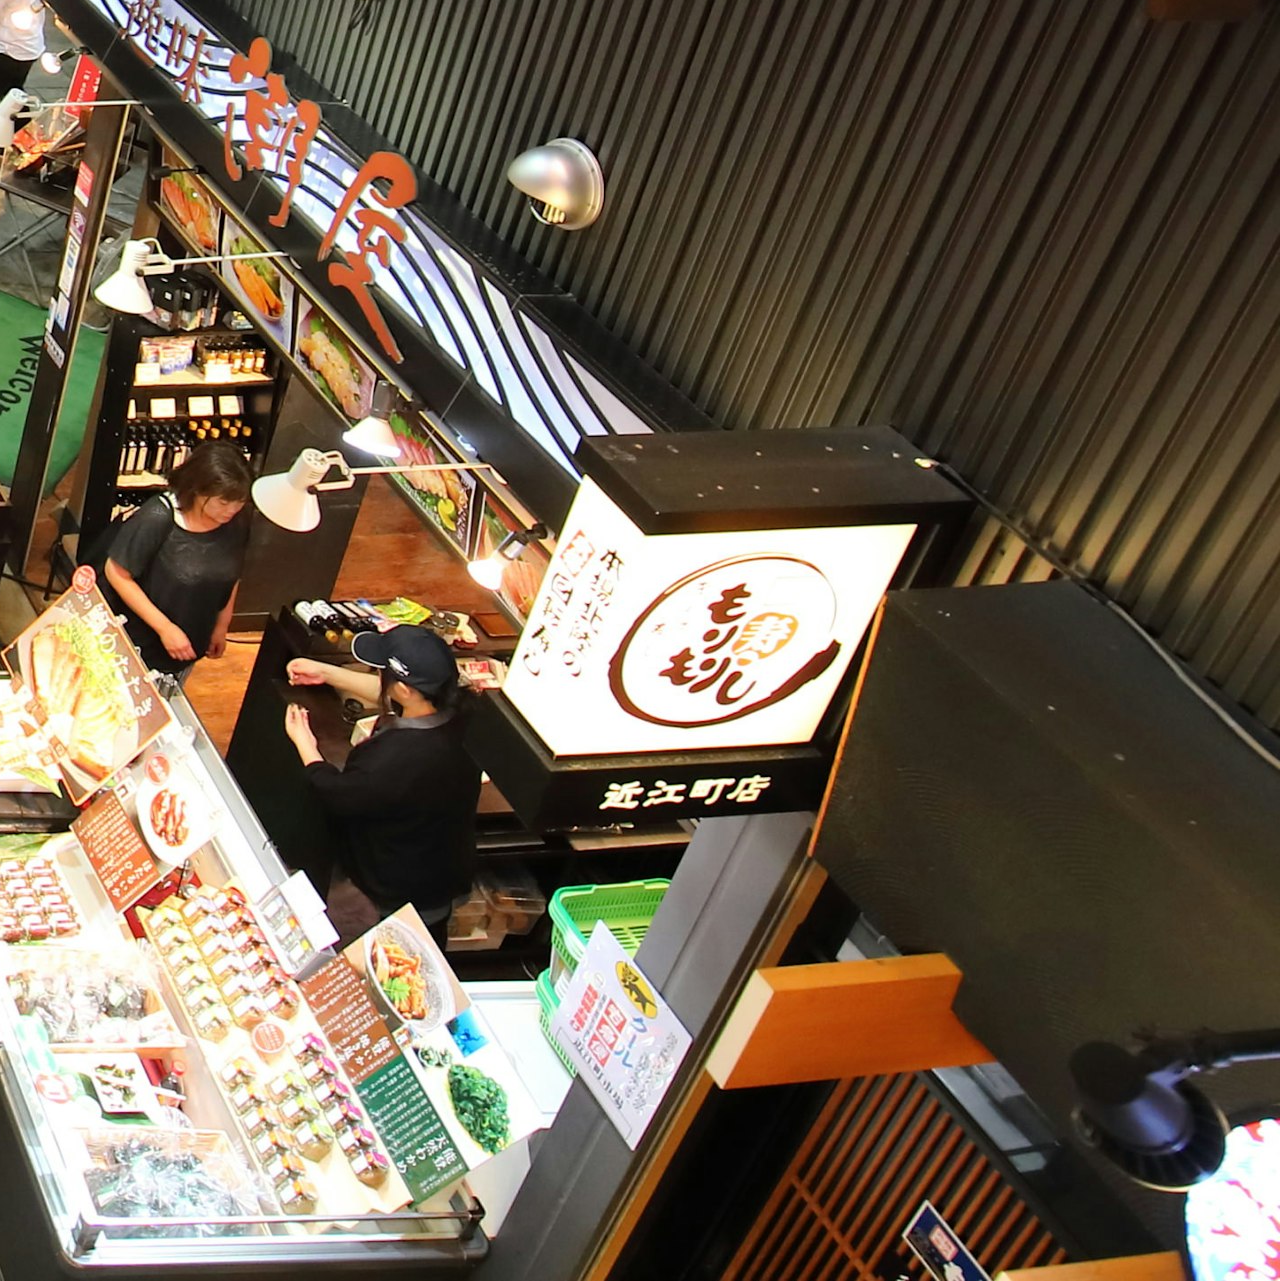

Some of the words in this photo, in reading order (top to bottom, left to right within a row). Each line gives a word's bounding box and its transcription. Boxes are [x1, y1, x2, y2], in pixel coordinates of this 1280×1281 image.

[598, 775, 772, 810] 近江町店
[397, 1132, 450, 1174] 天然わかめ
